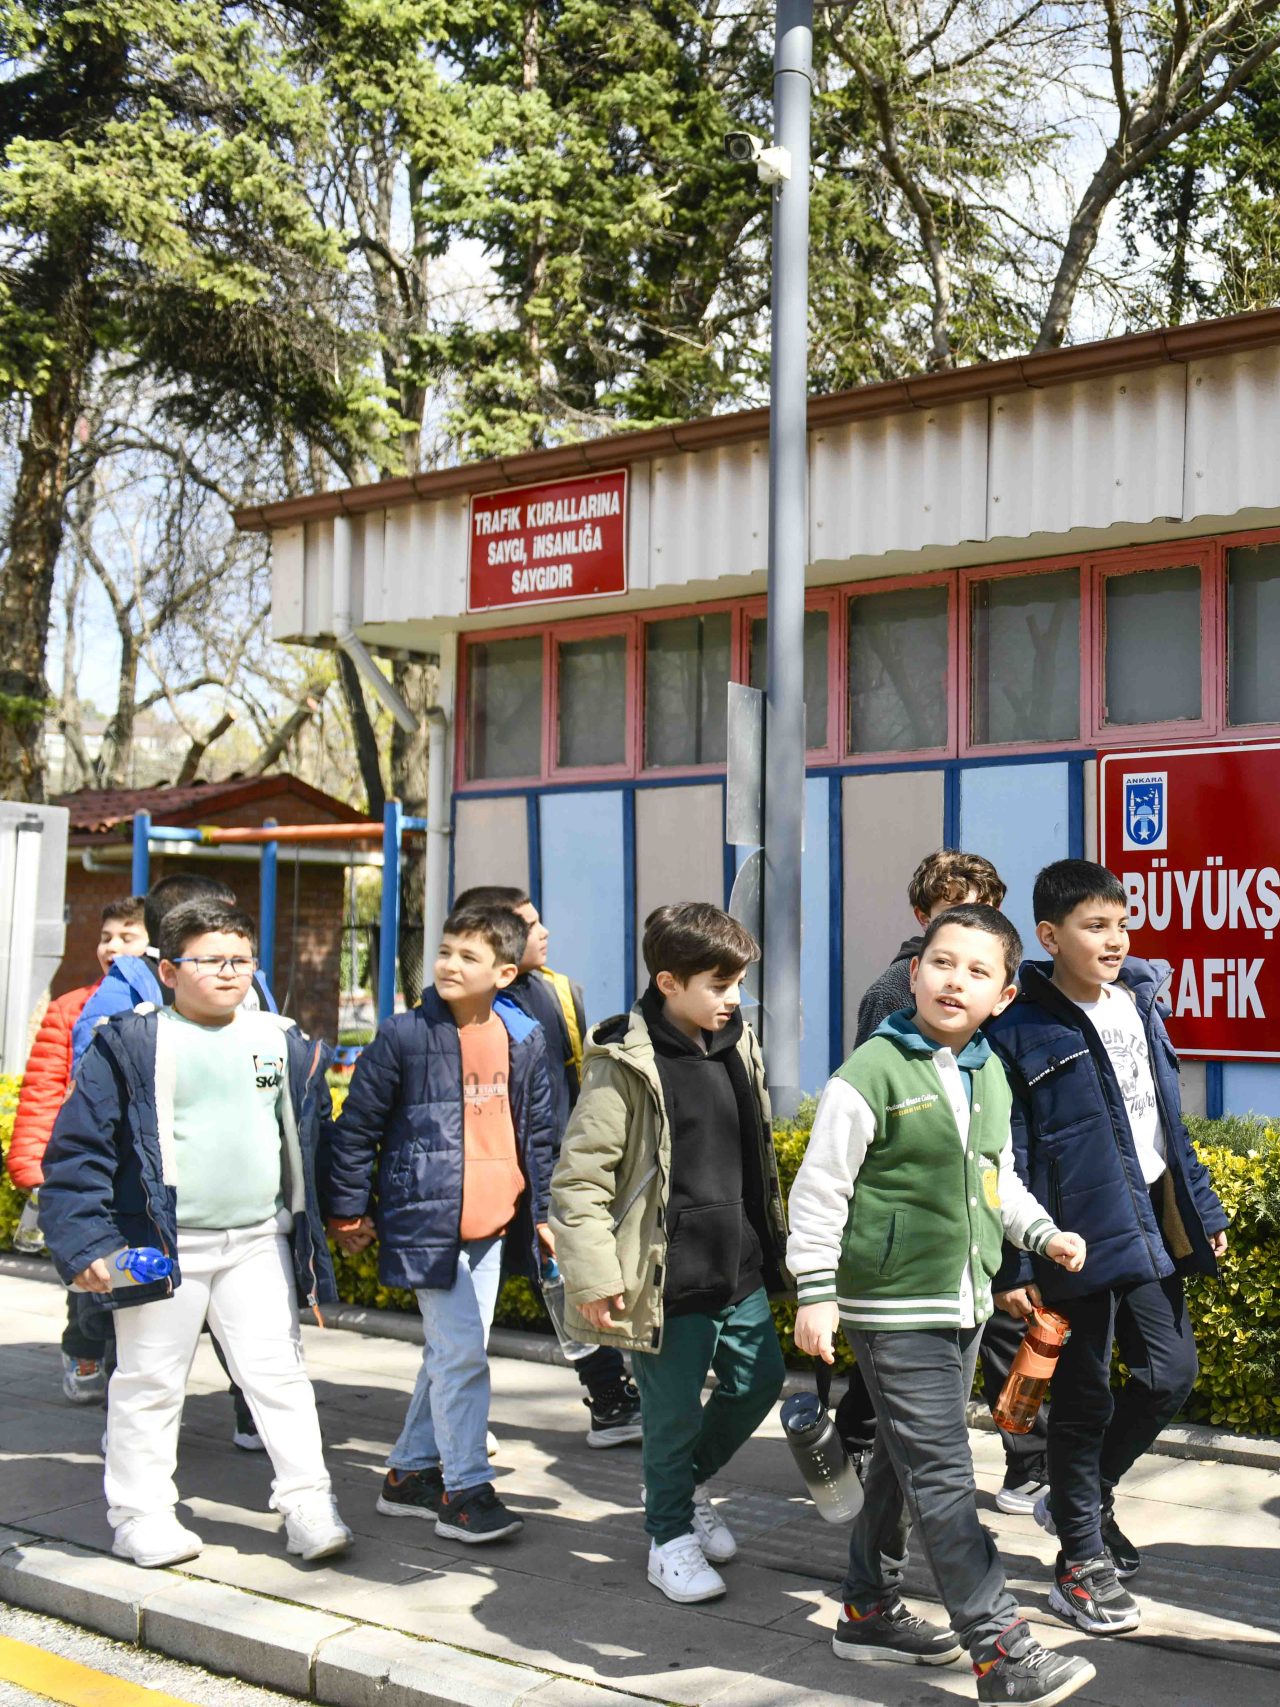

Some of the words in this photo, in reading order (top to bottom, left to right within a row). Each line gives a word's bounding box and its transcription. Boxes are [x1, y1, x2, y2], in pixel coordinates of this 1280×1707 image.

[526, 490, 621, 529] KURALLARINA
[511, 563, 573, 595] SAYGIDIR
[1126, 776, 1163, 784] ANKARA
[1101, 1028, 1124, 1045] ON
